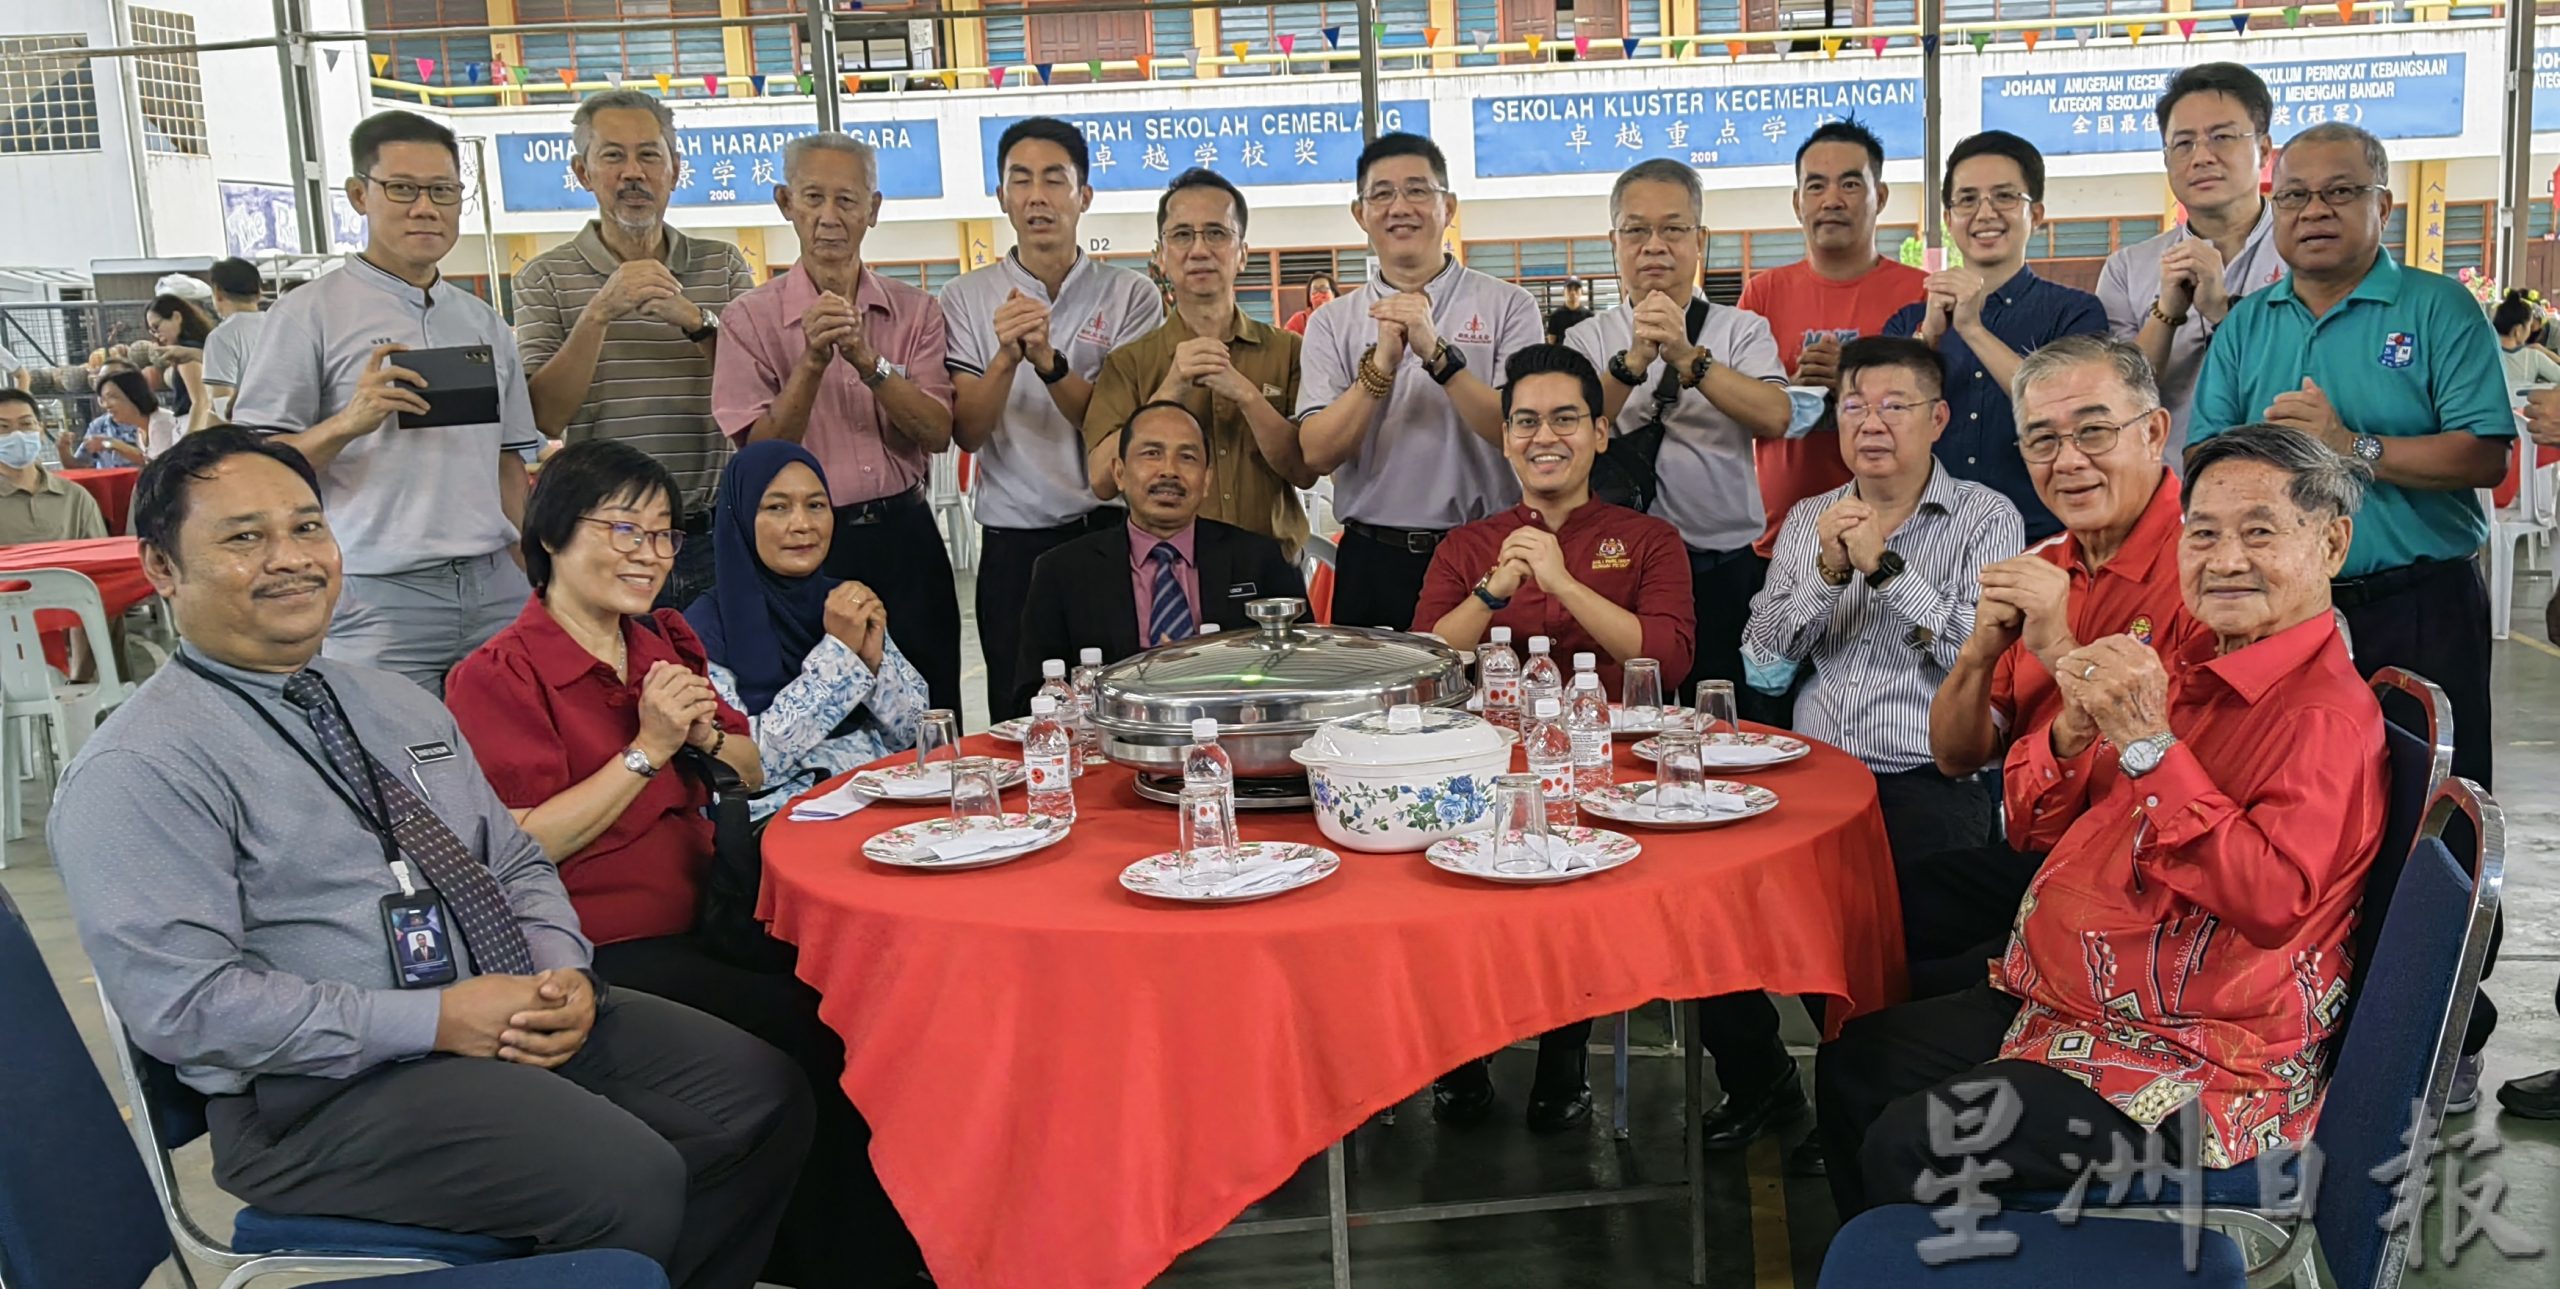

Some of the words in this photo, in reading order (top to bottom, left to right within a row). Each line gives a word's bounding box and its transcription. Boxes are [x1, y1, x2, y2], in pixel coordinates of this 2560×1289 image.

[2001, 78, 2057, 97] JOHAN
[2063, 75, 2124, 94] ANUGERAH
[2306, 63, 2368, 82] PERINGKAT
[2371, 59, 2447, 79] KEBANGSAAN
[1492, 97, 1594, 123] SEKOLAH
[1604, 92, 1704, 118] KLUSTER
[1715, 82, 1915, 113] KECEMERLANGAN
[2049, 96, 2102, 114] KATEGORI
[2106, 93, 2157, 112] SEKOLAH
[2286, 84, 2346, 102] MENENGAH
[2350, 82, 2394, 98] BANDAR
[1145, 115, 1249, 140] SEKOLAH
[1261, 108, 1402, 136] CEMERLAG
[523, 138, 579, 164] JOHA
[1091, 138, 1319, 175] 卓越学校奖
[709, 189, 736, 201] 2006
[1090, 237, 1110, 251] D2
